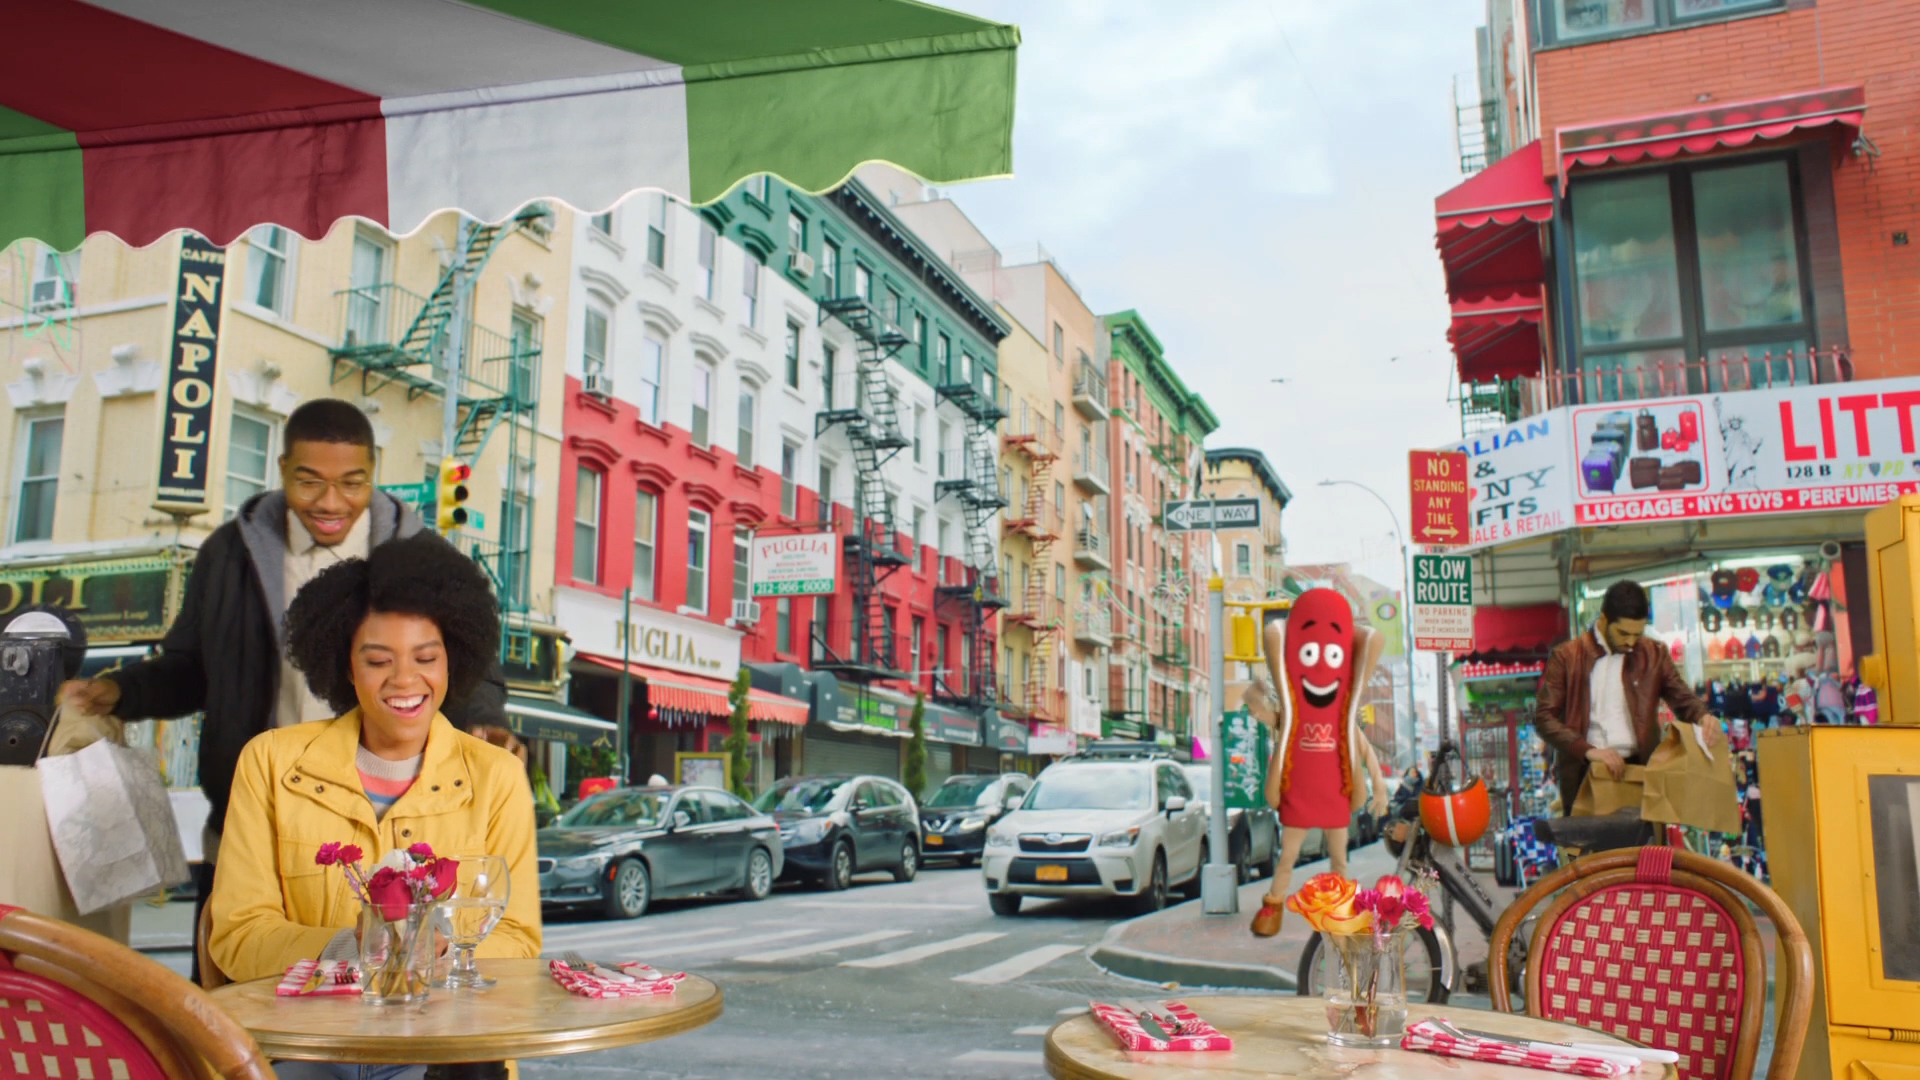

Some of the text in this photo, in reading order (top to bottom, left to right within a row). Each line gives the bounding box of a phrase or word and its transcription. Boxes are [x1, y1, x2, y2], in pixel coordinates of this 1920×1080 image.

[169, 272, 221, 480] NAPOLI
[1779, 390, 1920, 462] LITT
[1427, 458, 1450, 477] NO
[1474, 461, 1496, 479] &
[1786, 464, 1832, 478] 128 B
[1413, 479, 1465, 494] STANDING
[1481, 465, 1555, 502] NY
[1427, 496, 1452, 510] ANY
[1583, 498, 1686, 521] LUGGAGE
[1697, 492, 1734, 514] NYC
[1737, 489, 1784, 511] TOYS
[1798, 482, 1900, 507] PERFUMES
[1174, 506, 1252, 522] ONE WAY
[1426, 511, 1455, 526] TIME
[1503, 521, 1512, 538] &
[1517, 510, 1565, 535] RETAIL
[761, 538, 829, 559] PUGLIA
[1418, 559, 1466, 580] SLOW
[1416, 581, 1470, 603] ROUTE
[1418, 606, 1468, 616] NO PARKING
[1453, 639, 1471, 650] ZONE
